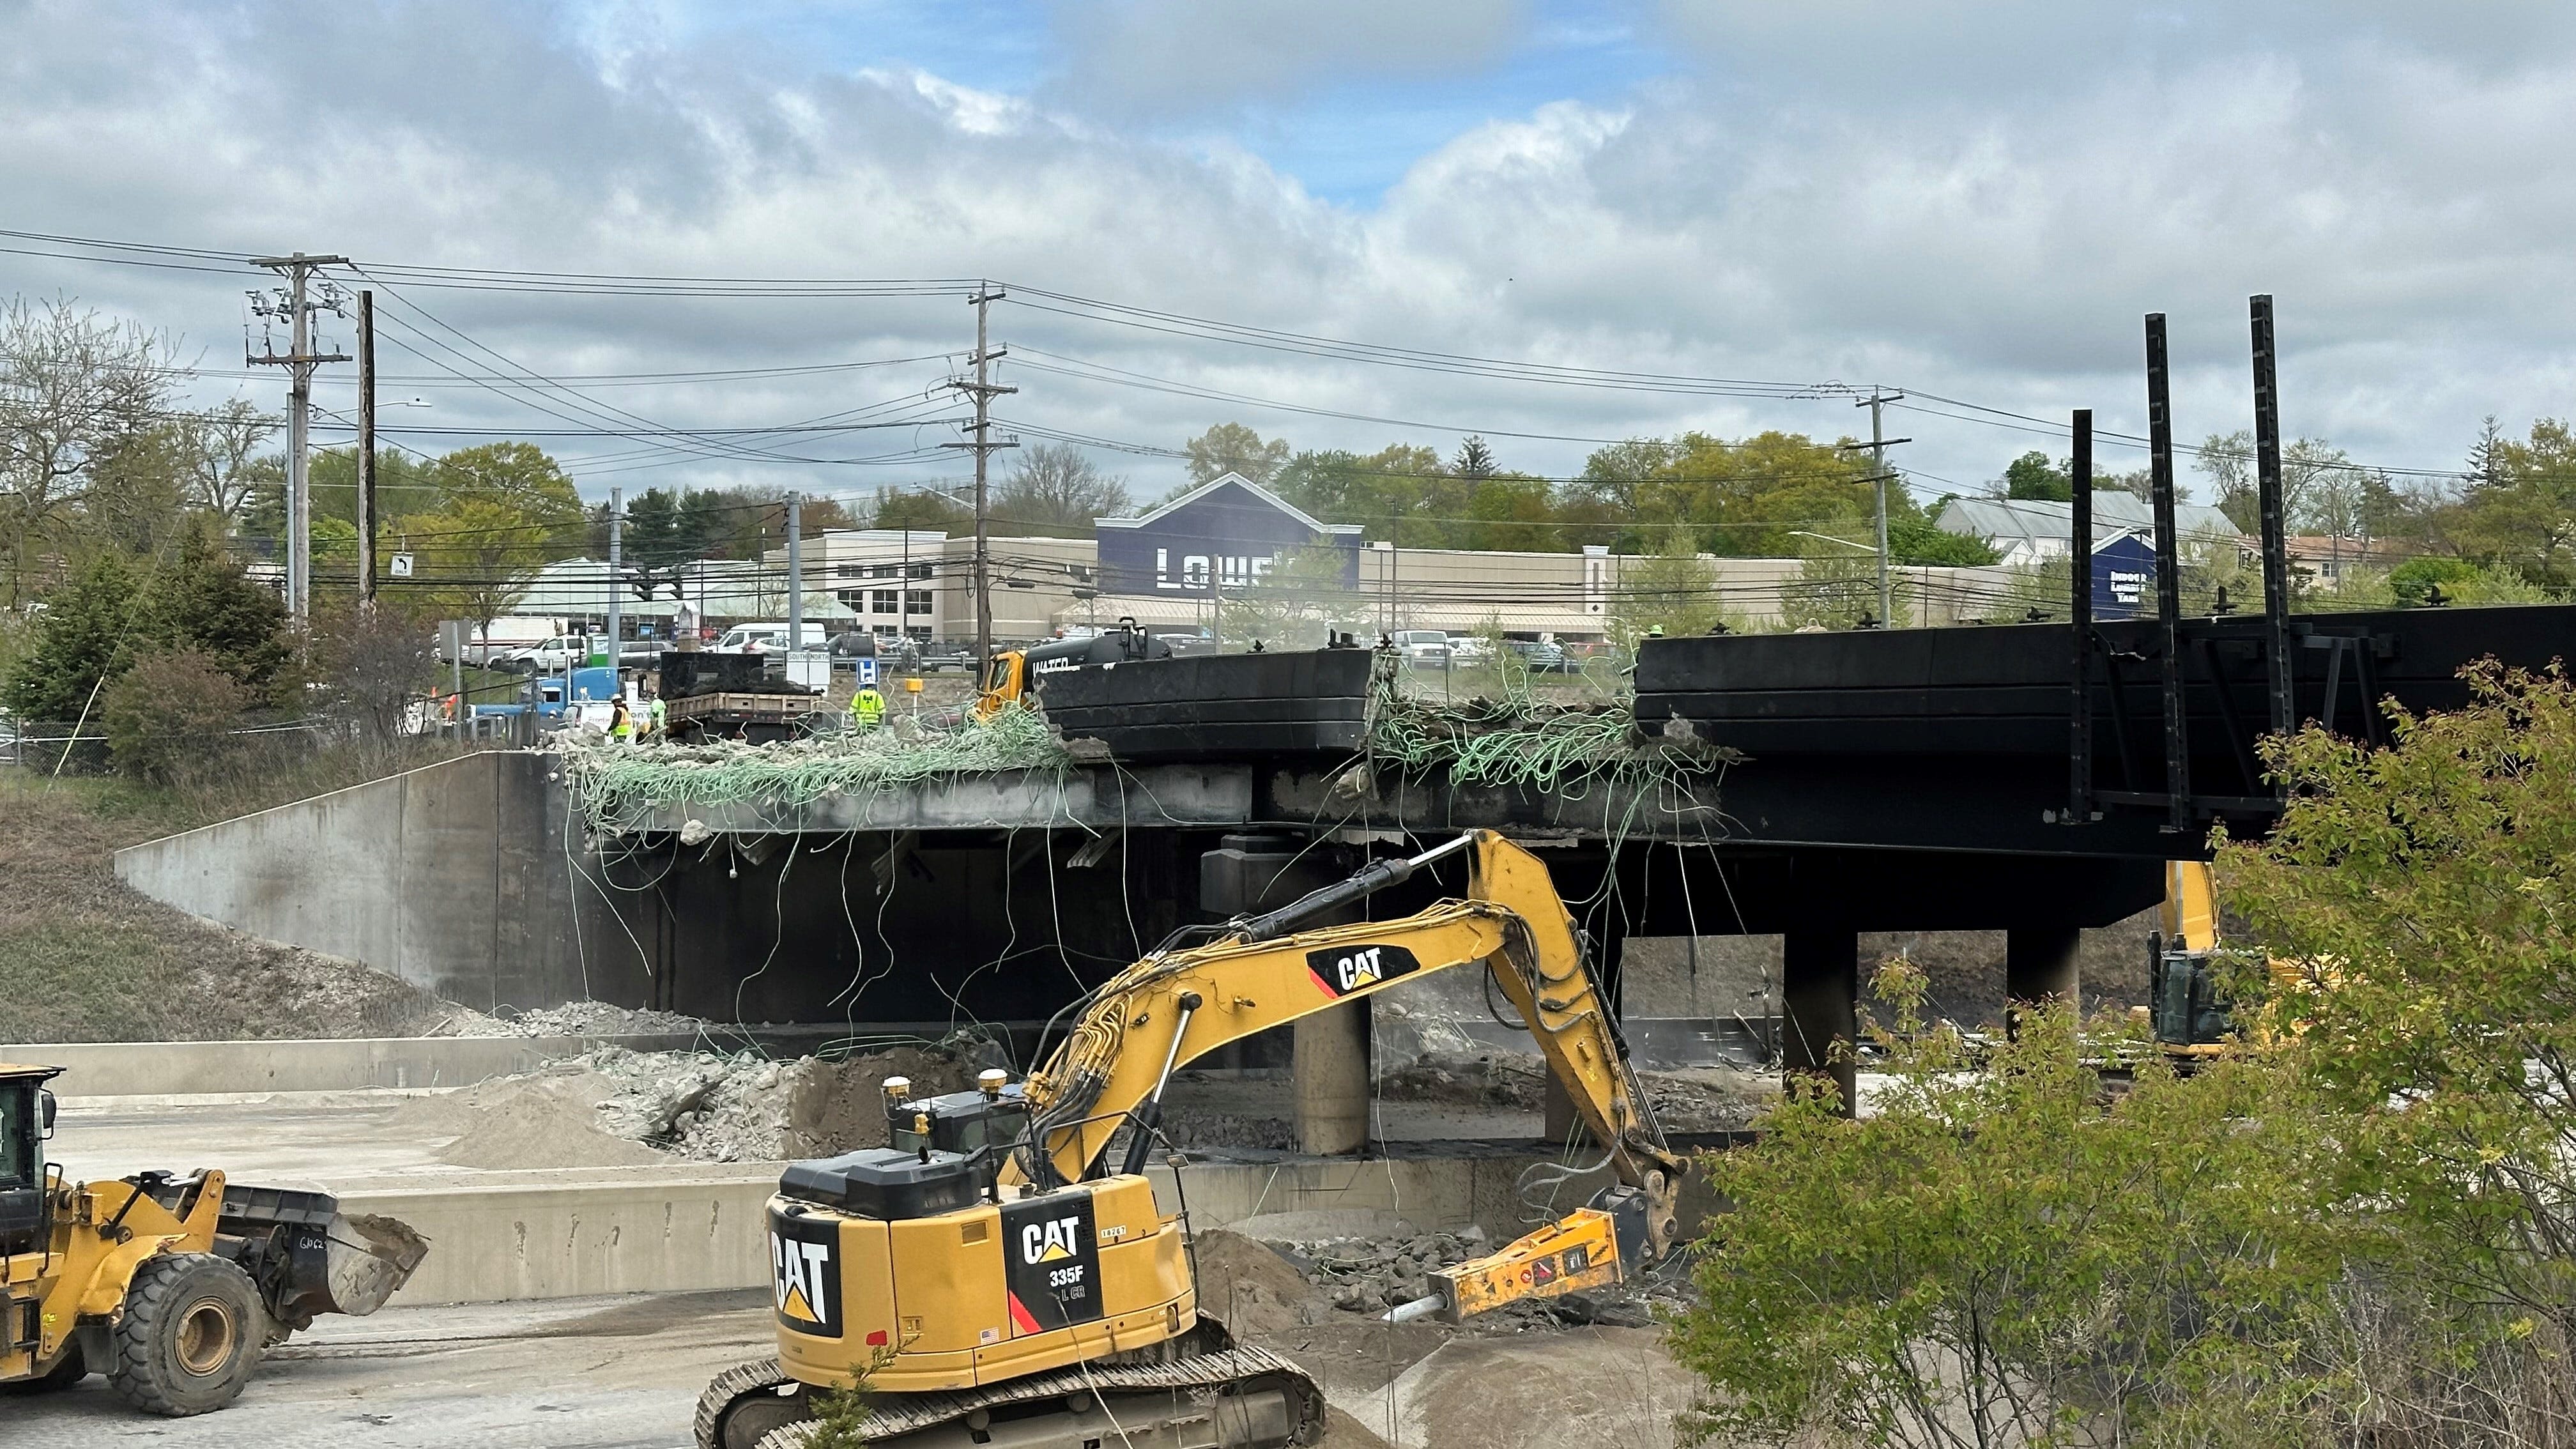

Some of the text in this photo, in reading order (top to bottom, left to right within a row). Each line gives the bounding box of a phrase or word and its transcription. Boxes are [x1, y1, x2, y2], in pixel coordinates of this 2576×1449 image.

[859, 661, 877, 683] H
[1338, 947, 1382, 991] CAT
[1022, 1216, 1079, 1265] CAT
[770, 1230, 829, 1324] CAT
[1049, 1264, 1084, 1287] 335F
[1061, 1285, 1085, 1301] L CR
